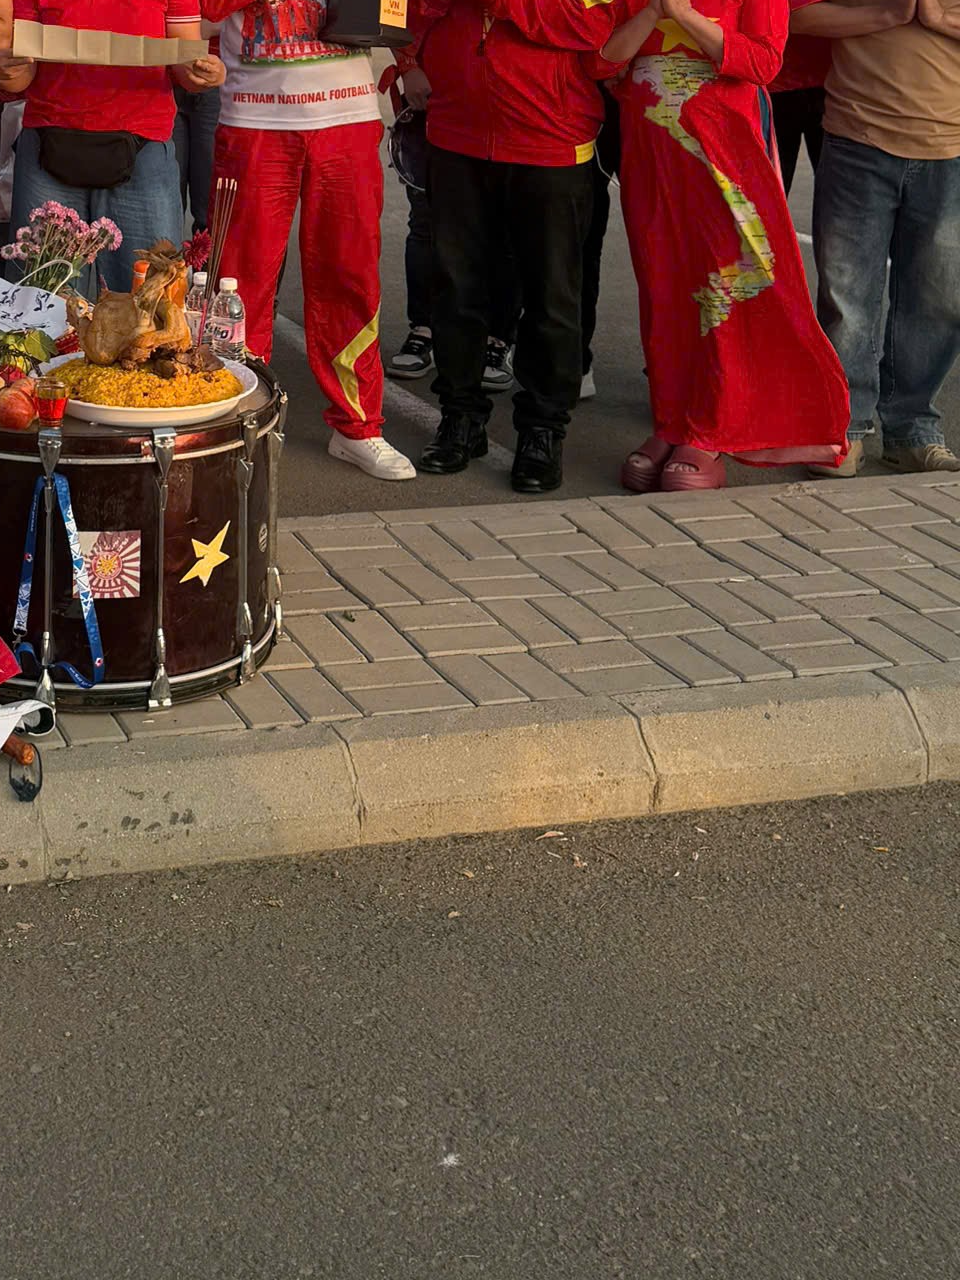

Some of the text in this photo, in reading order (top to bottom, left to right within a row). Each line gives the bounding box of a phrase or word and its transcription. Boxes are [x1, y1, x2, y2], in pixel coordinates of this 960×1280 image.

[389, 0, 400, 10] VN
[233, 91, 275, 104] VIETNAM
[278, 91, 327, 105] NATIONAL
[329, 84, 370, 101] FOOTBALL
